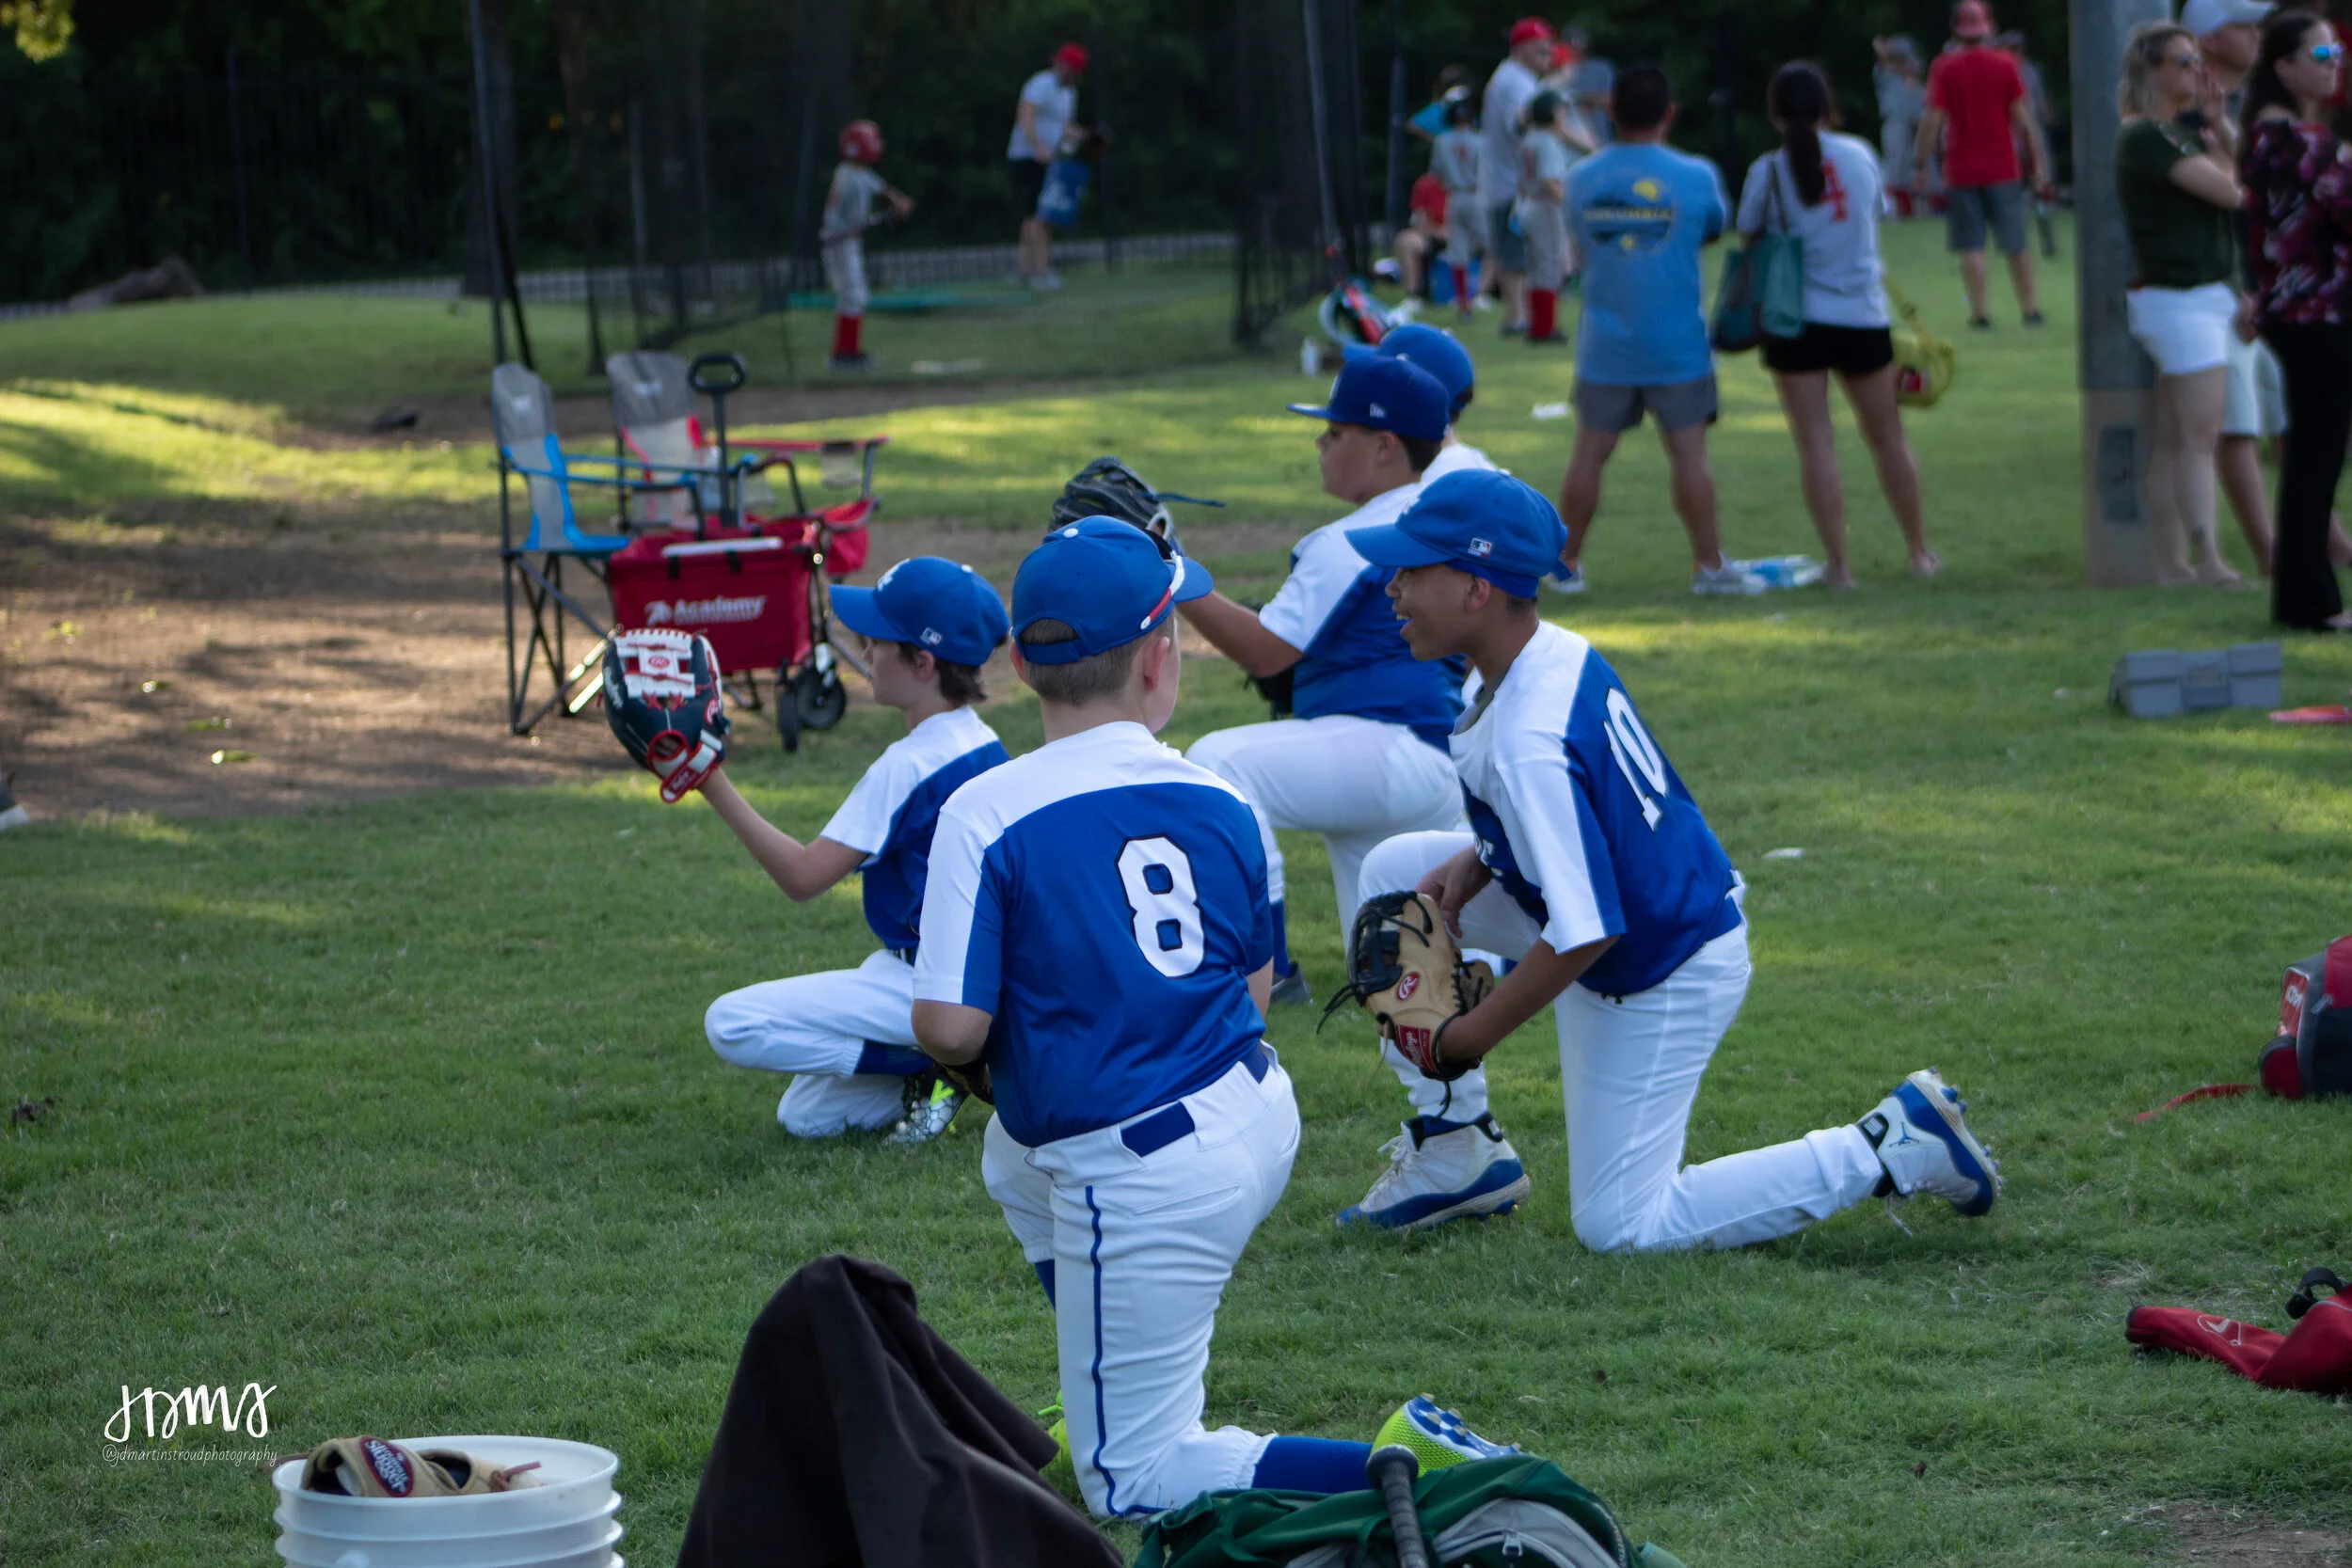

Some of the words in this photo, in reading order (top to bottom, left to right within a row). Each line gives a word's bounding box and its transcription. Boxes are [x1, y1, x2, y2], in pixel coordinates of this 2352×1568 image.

[675, 594, 768, 620] Academy
[1603, 687, 1667, 832] 10
[1114, 832, 1207, 980] 8
